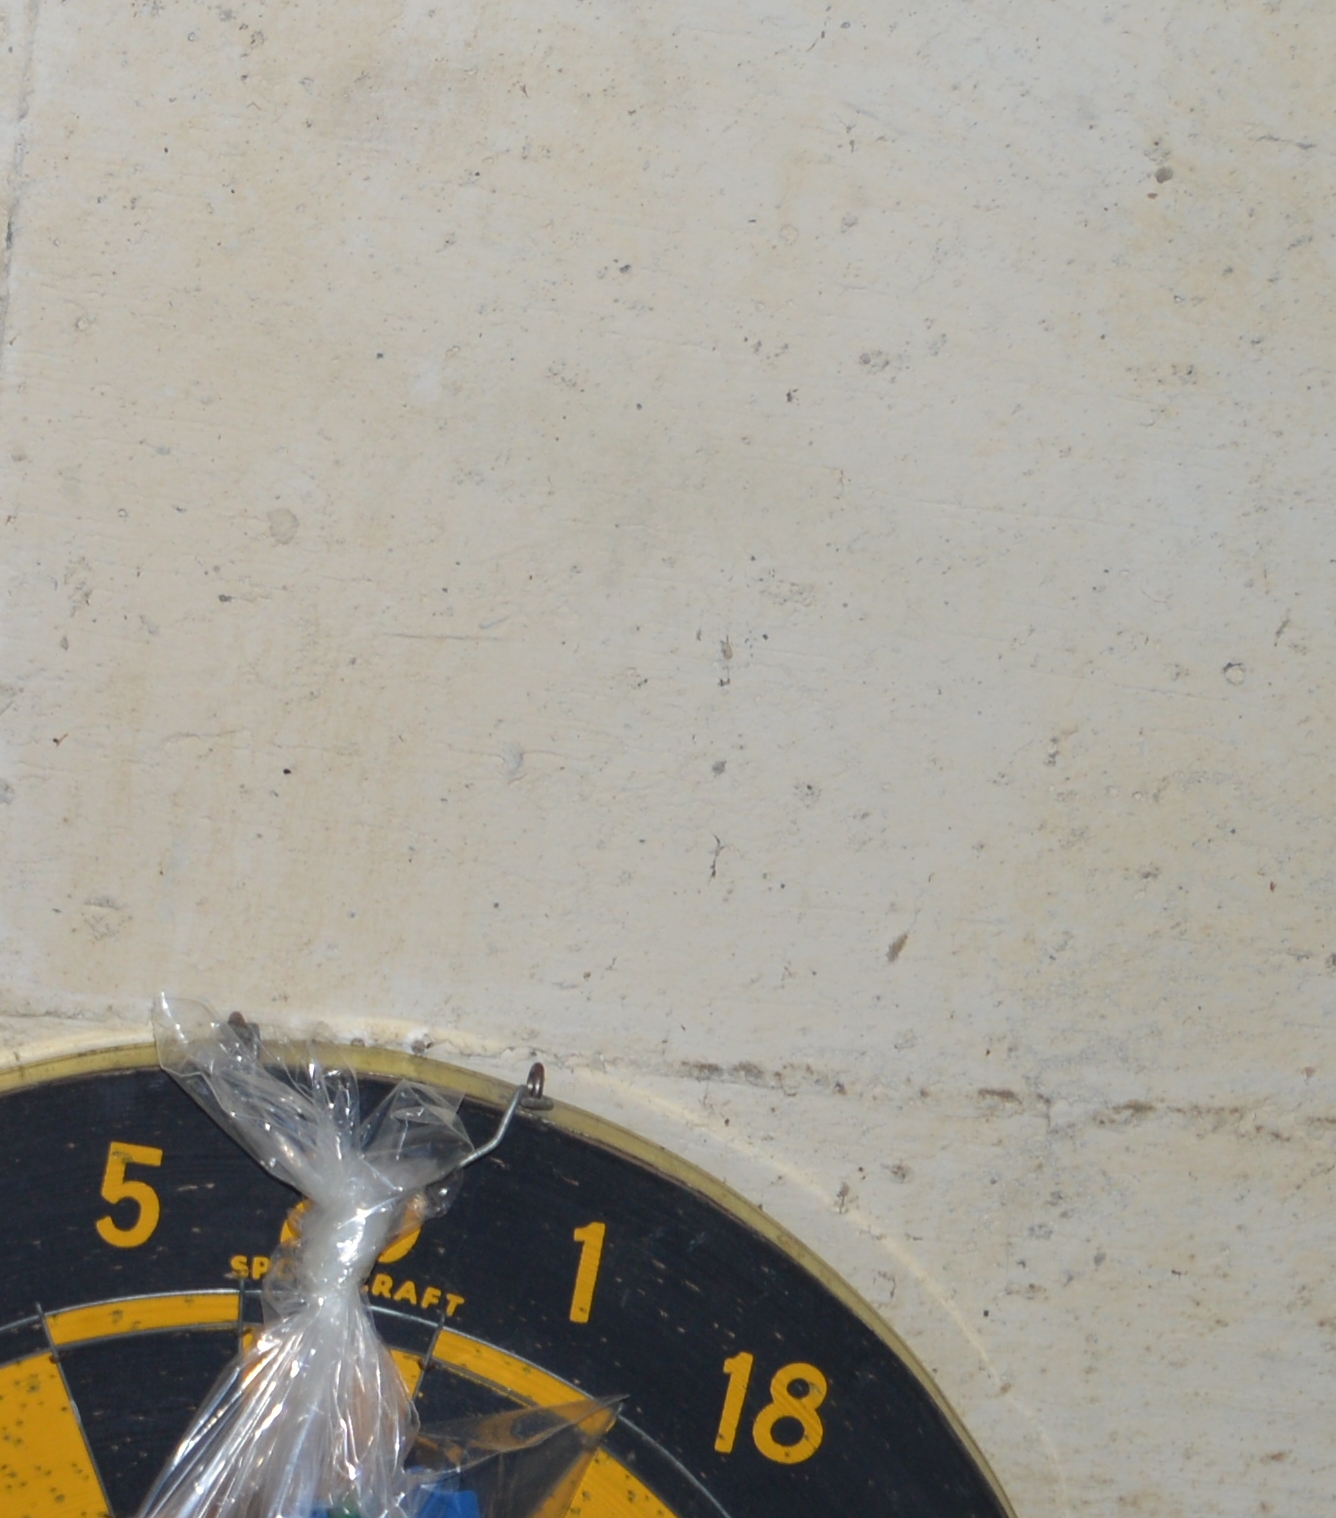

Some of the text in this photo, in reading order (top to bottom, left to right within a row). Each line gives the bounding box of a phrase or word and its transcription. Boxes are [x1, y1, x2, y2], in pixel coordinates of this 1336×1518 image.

[95, 1141, 163, 1248] 5
[569, 1221, 606, 1324] 1
[714, 1351, 828, 1465] 18
